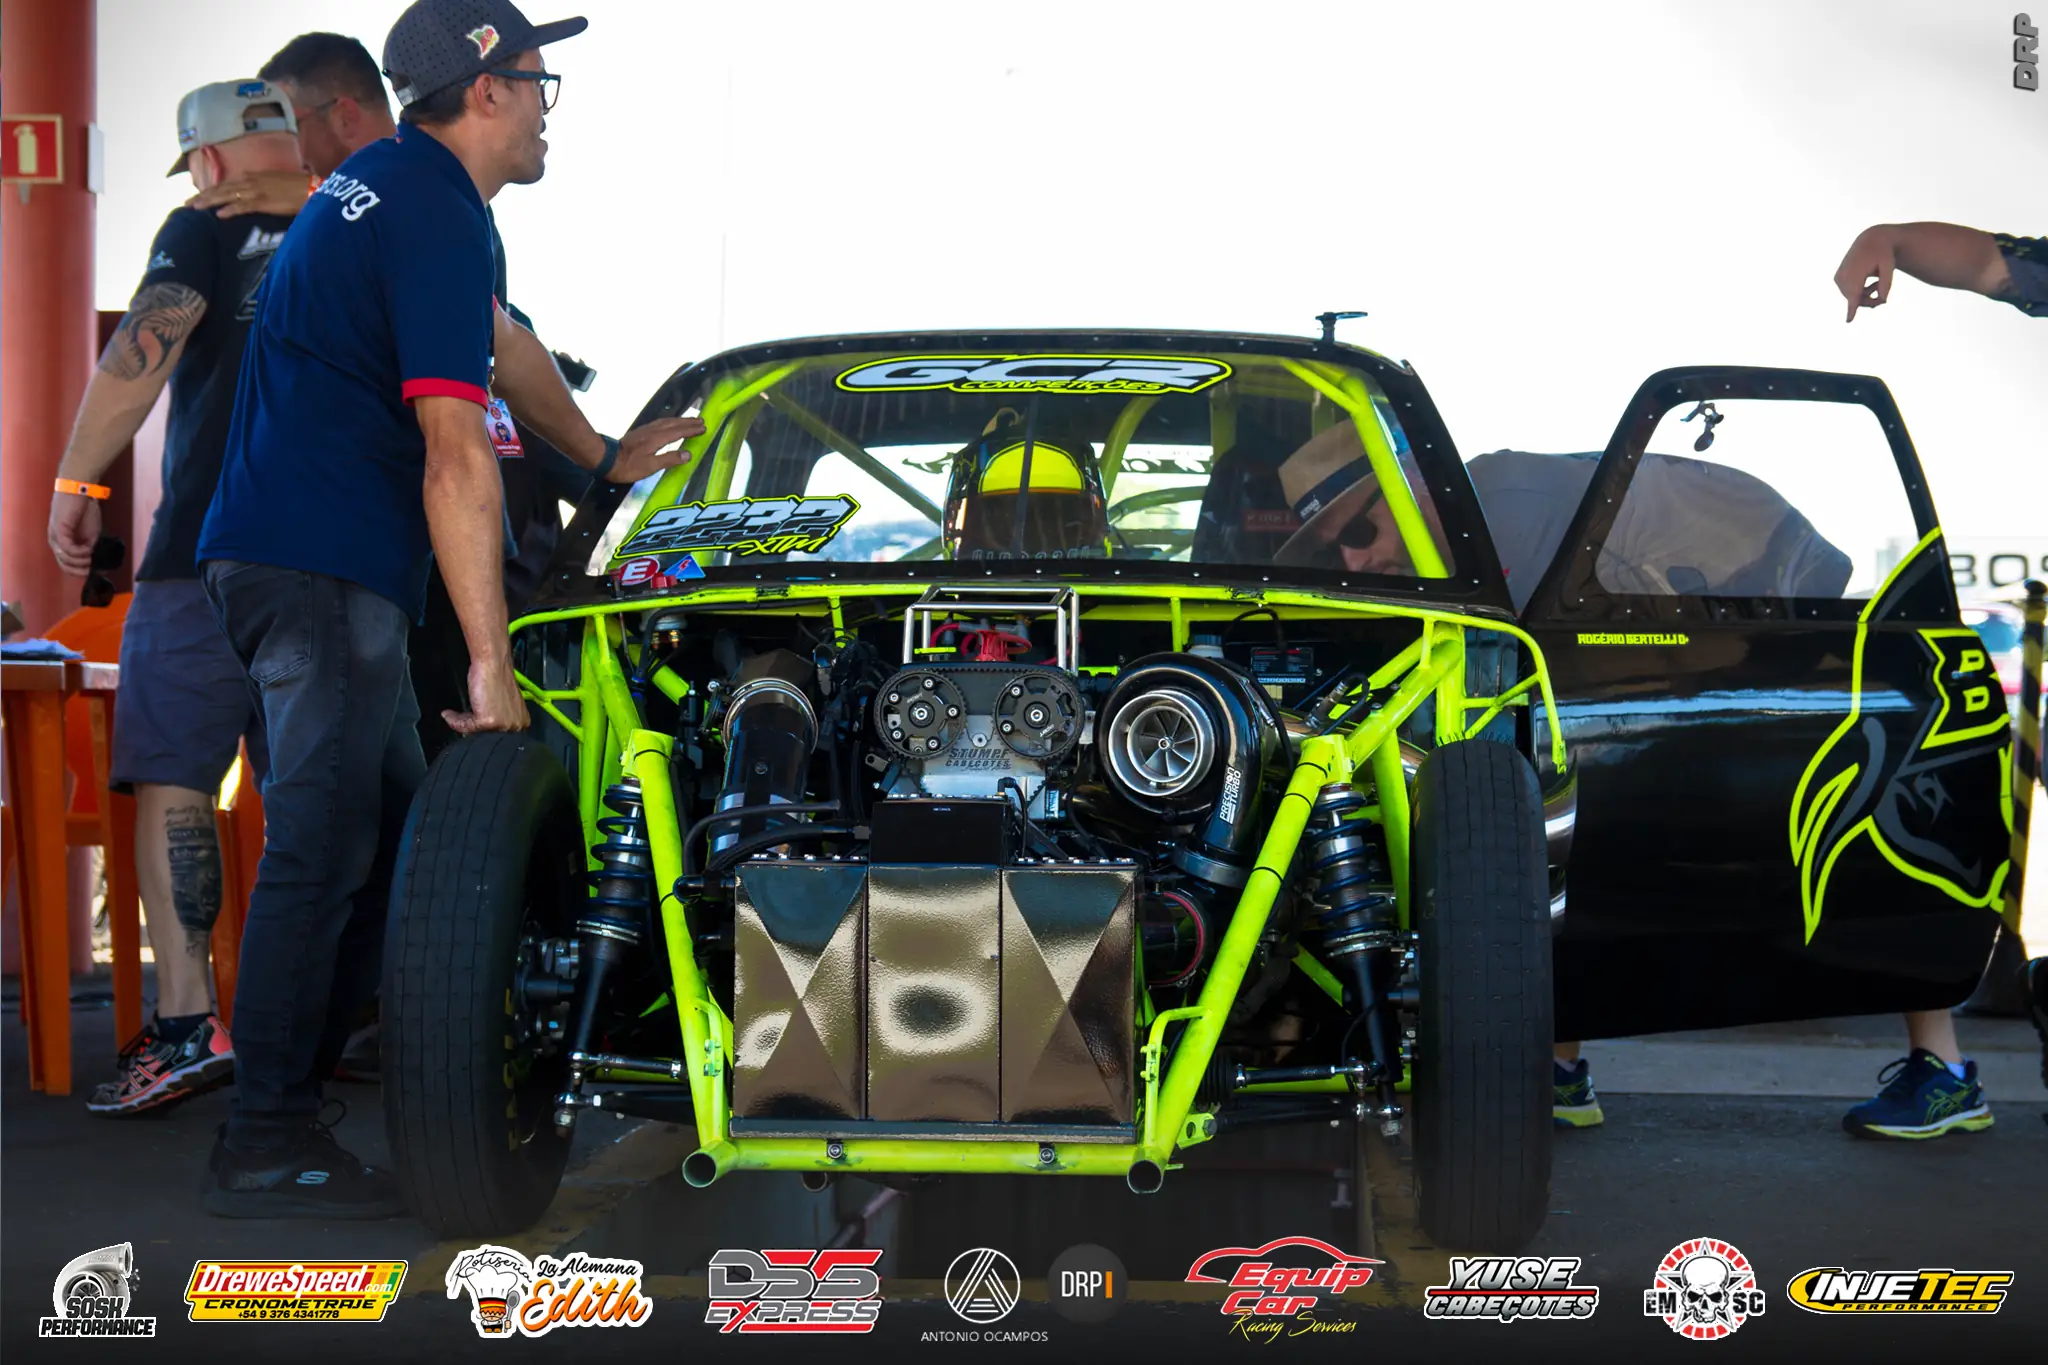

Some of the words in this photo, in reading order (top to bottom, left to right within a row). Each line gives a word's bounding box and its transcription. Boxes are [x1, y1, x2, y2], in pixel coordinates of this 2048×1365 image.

[844, 358, 1221, 387] GCR
[948, 747, 1010, 760] STUMPF
[1230, 769, 1242, 804] TURBO
